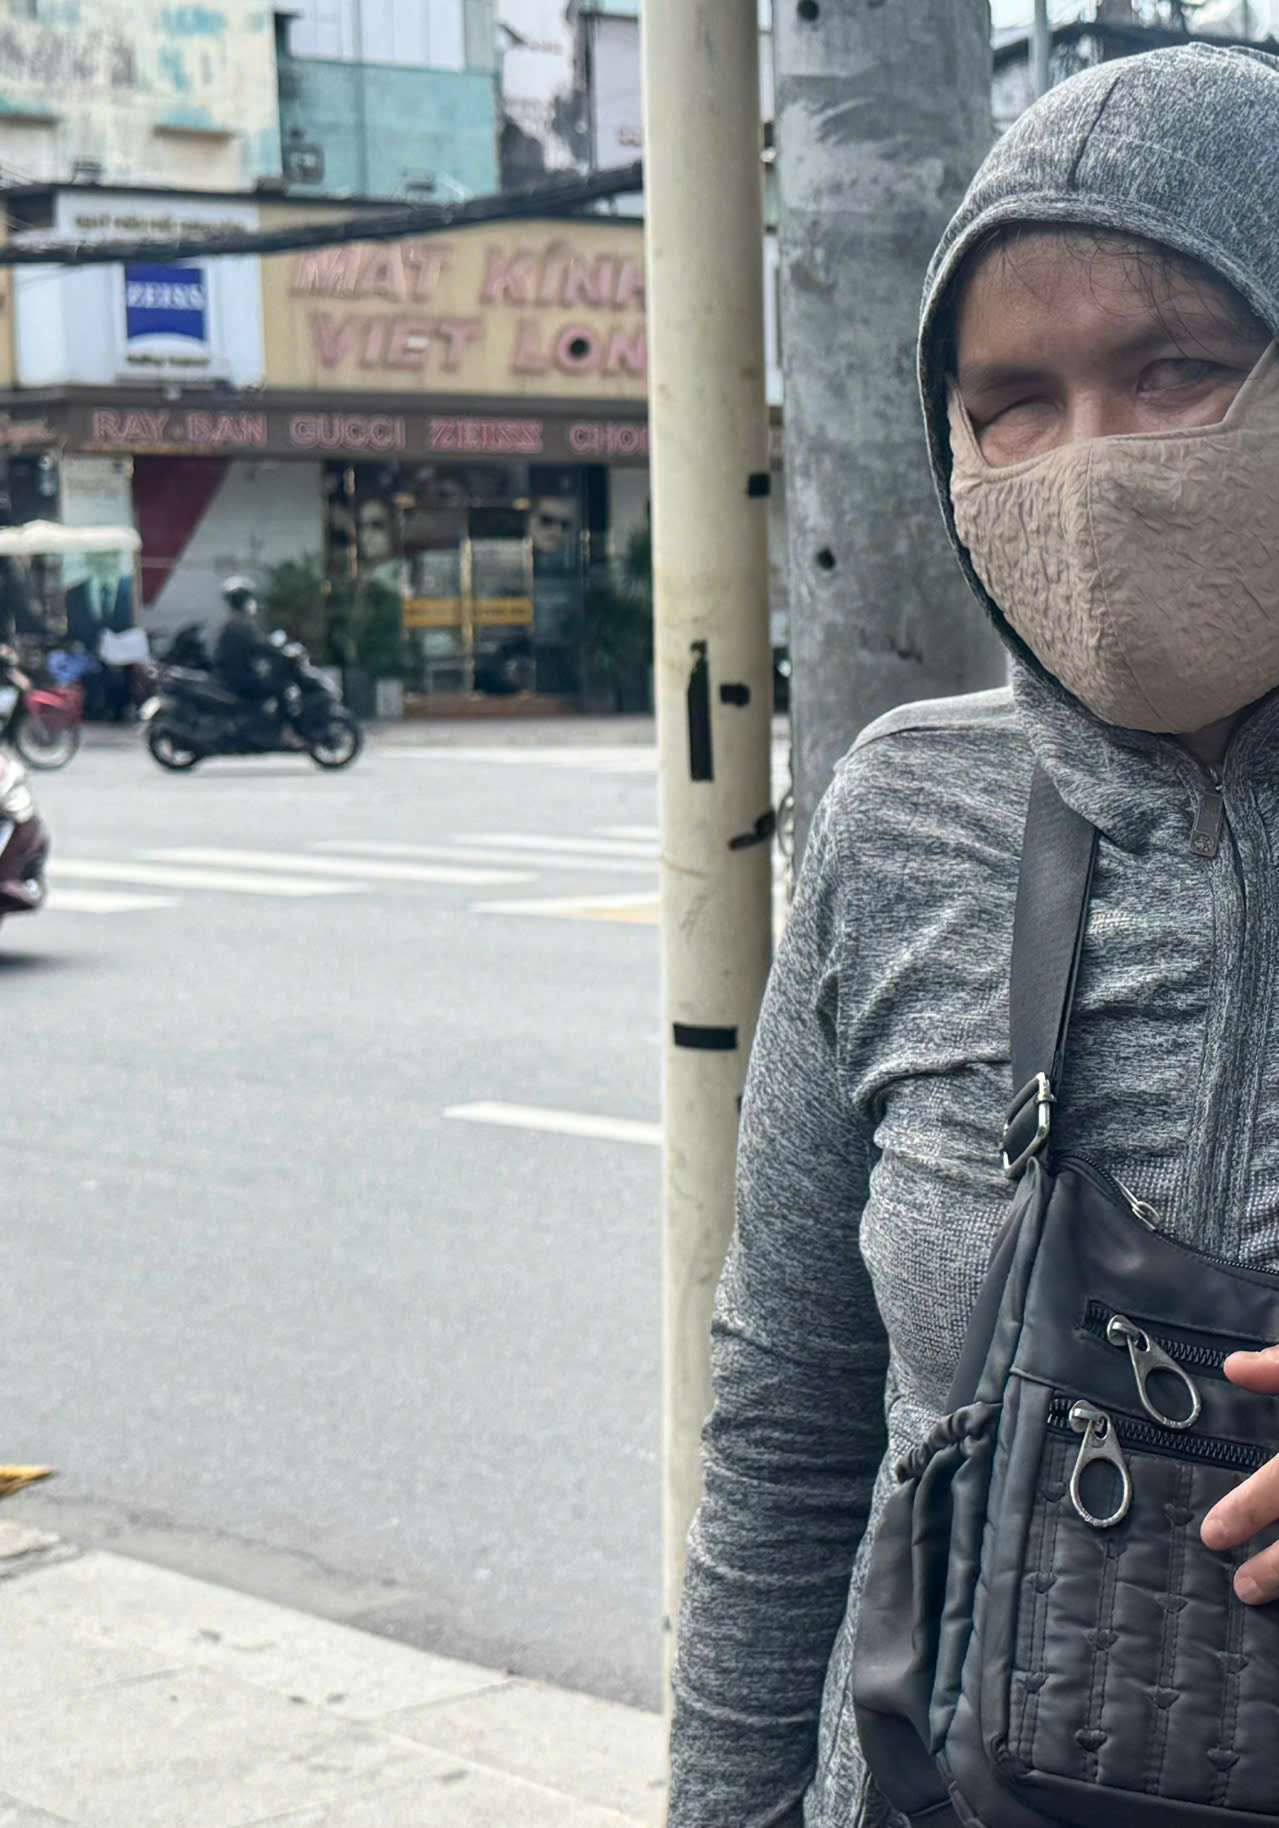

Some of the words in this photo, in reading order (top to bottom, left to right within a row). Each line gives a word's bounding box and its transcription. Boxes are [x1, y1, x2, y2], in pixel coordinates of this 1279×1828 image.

[288, 415, 406, 448] GUCCI
[430, 418, 543, 454] ZEISS
[568, 421, 647, 454] CHO
